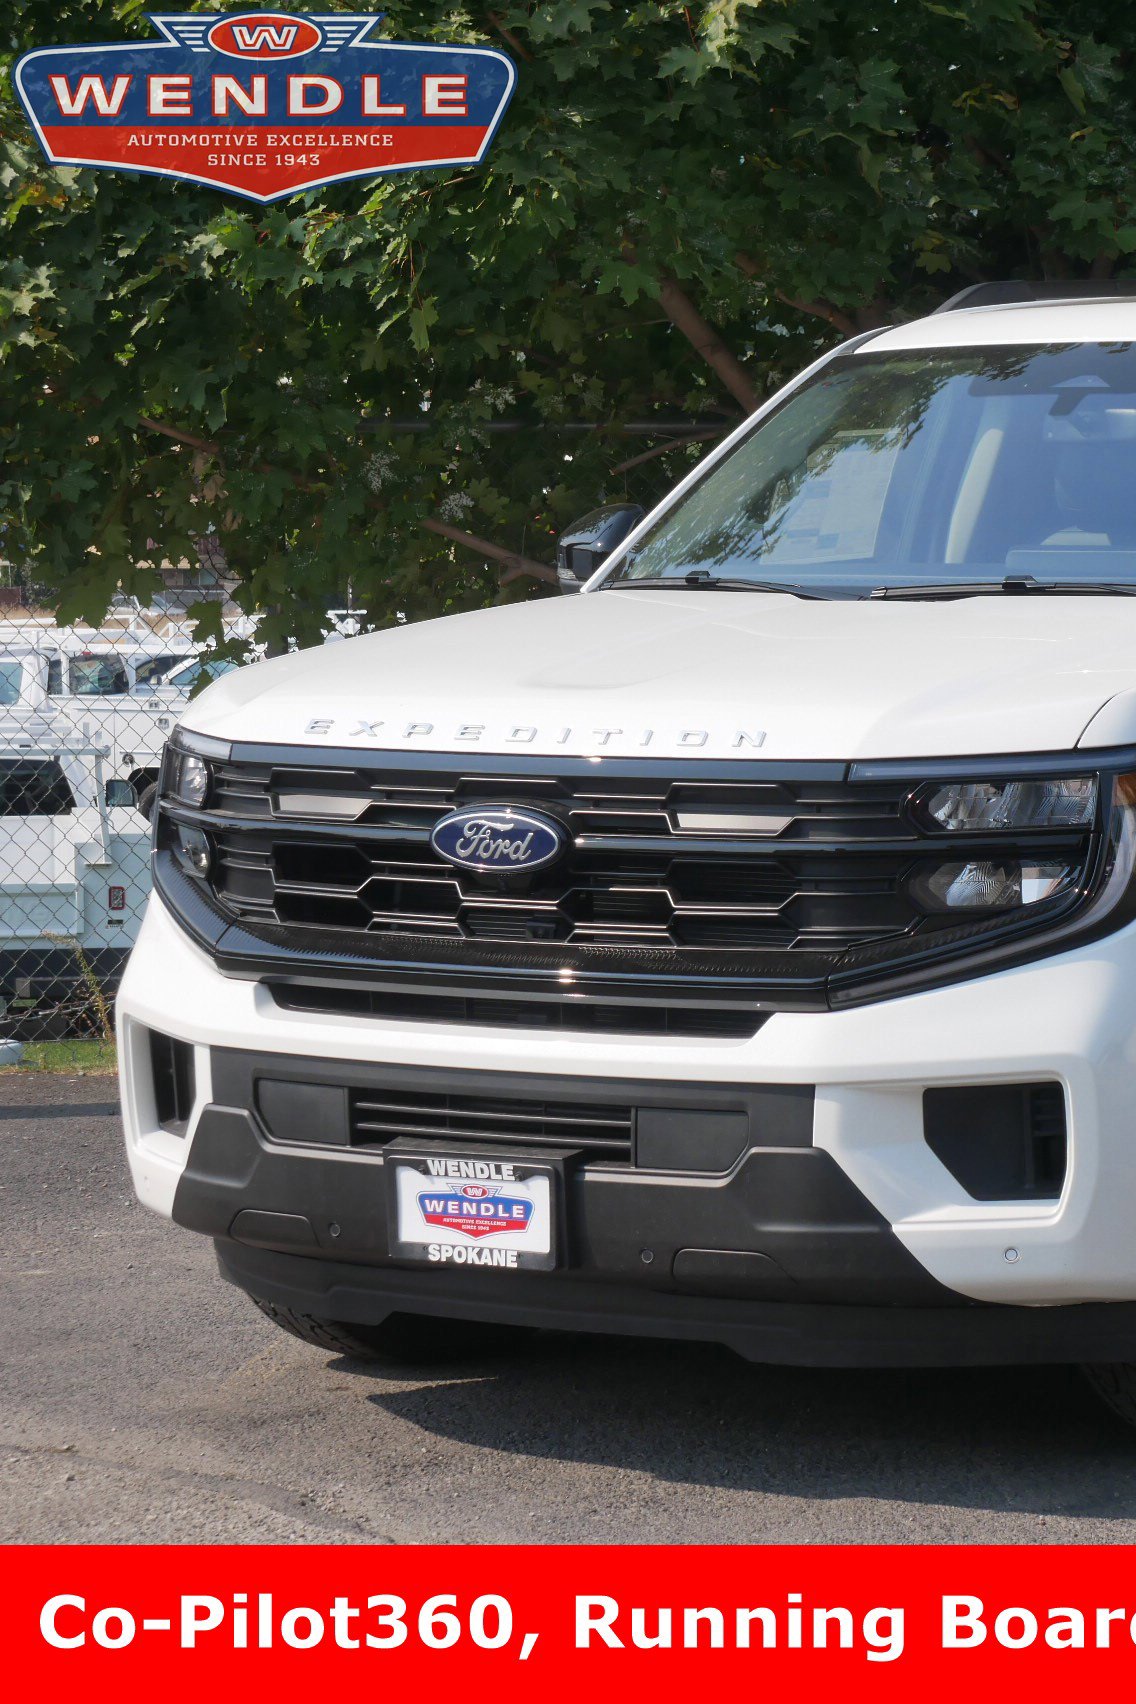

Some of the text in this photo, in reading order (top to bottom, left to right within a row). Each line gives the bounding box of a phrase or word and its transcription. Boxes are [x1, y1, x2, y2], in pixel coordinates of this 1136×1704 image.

[304, 718, 768, 748] EXPEDITION
[455, 819, 531, 861] Ford
[427, 1160, 515, 1181] WENDLE
[425, 1199, 524, 1218] WENDLE
[428, 1244, 517, 1267] SPOKANE
